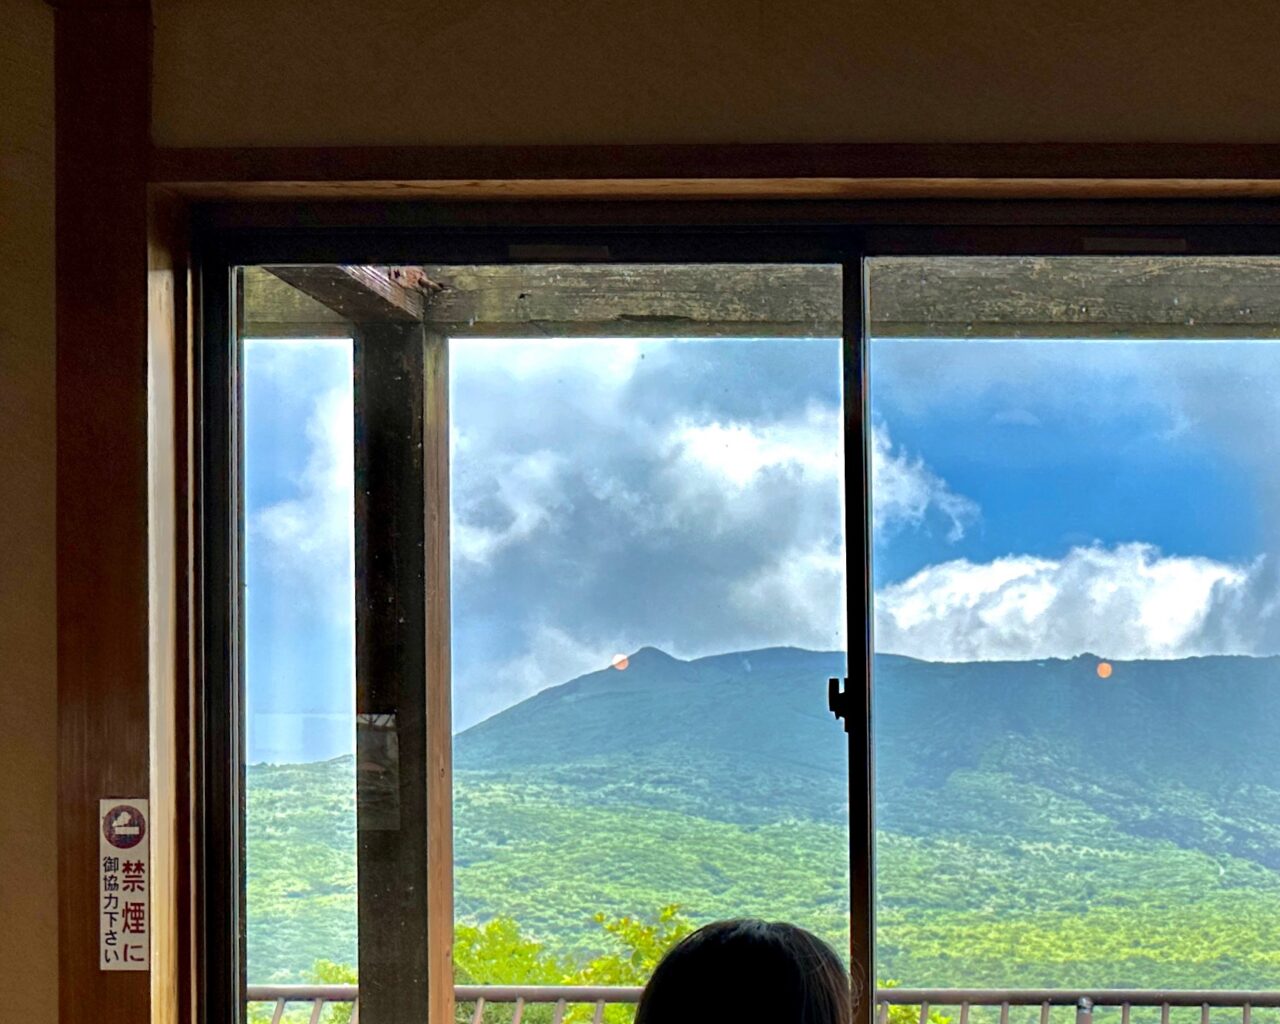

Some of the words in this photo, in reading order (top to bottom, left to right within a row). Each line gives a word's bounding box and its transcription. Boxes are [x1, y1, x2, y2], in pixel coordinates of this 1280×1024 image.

[103, 856, 119, 963] 御協力下さい
[122, 860, 145, 962] 禁煙に
